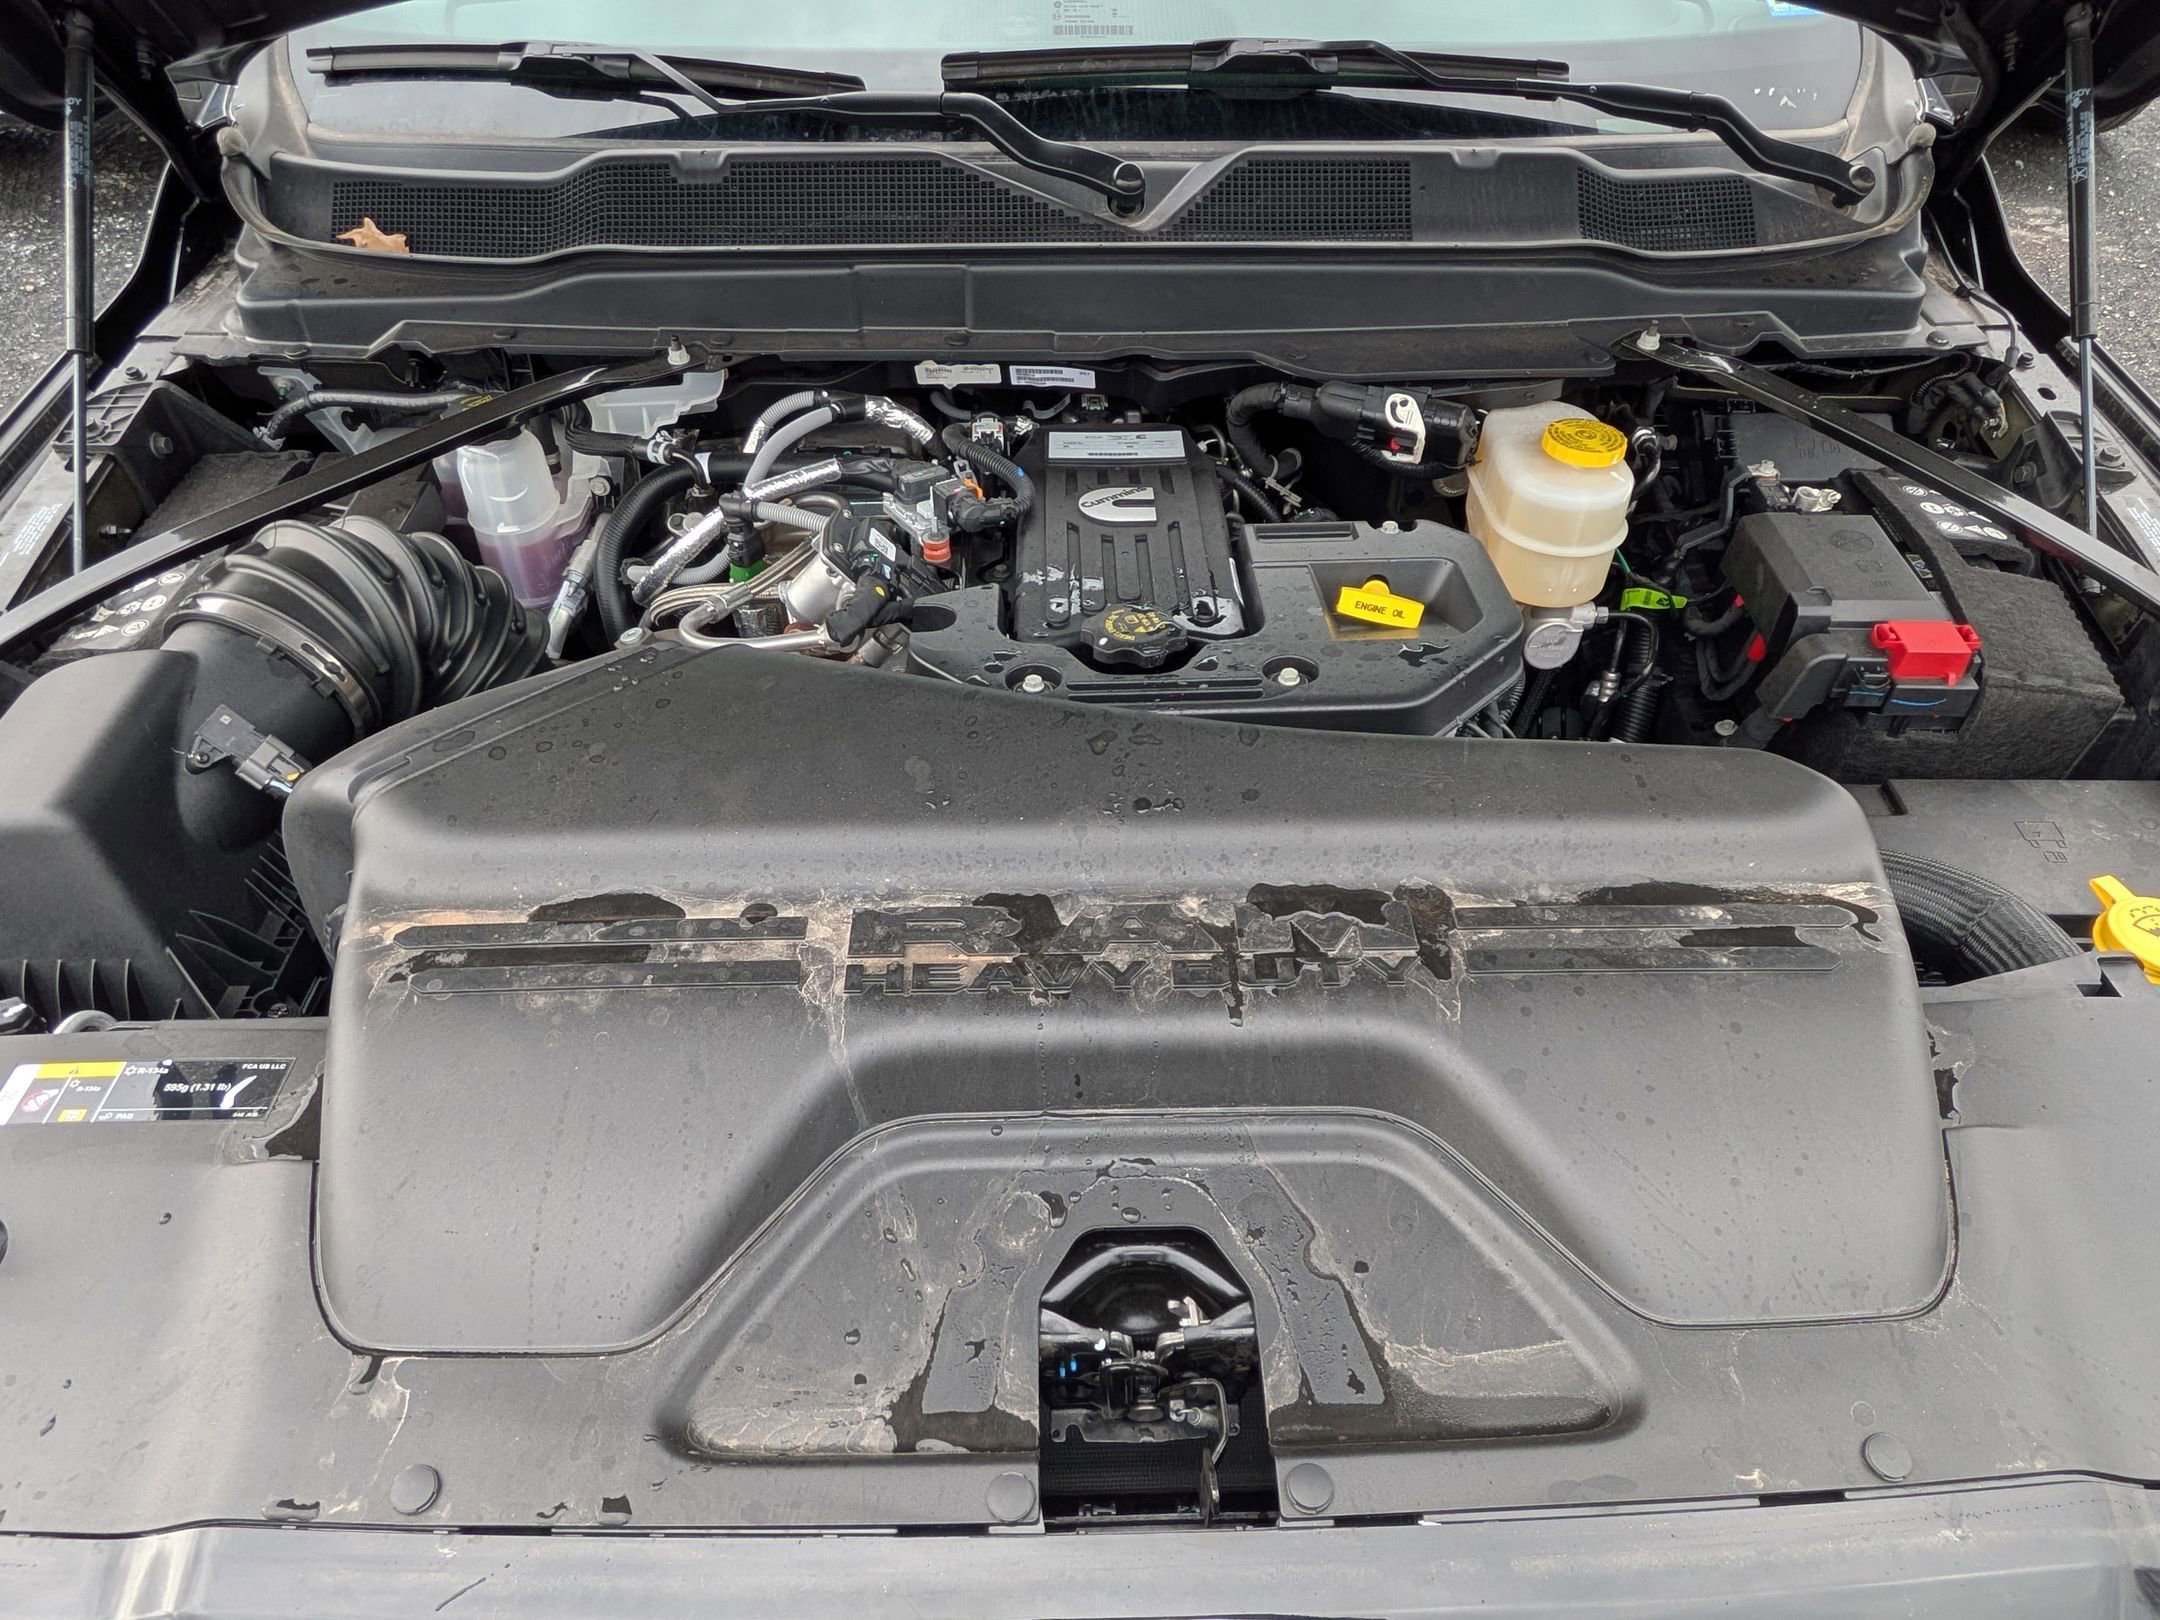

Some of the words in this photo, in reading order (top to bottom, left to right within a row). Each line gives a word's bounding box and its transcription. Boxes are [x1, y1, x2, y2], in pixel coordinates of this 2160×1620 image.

[1354, 600, 1387, 615] ENGINE
[1392, 608, 1406, 619] OIL
[846, 902, 1420, 959] RAM
[843, 959, 1152, 995] HEAVY
[1170, 957, 1422, 989] DUTY
[137, 1066, 169, 1075] R-134a
[163, 1083, 190, 1094] 595g
[190, 1083, 216, 1093] (1.31
